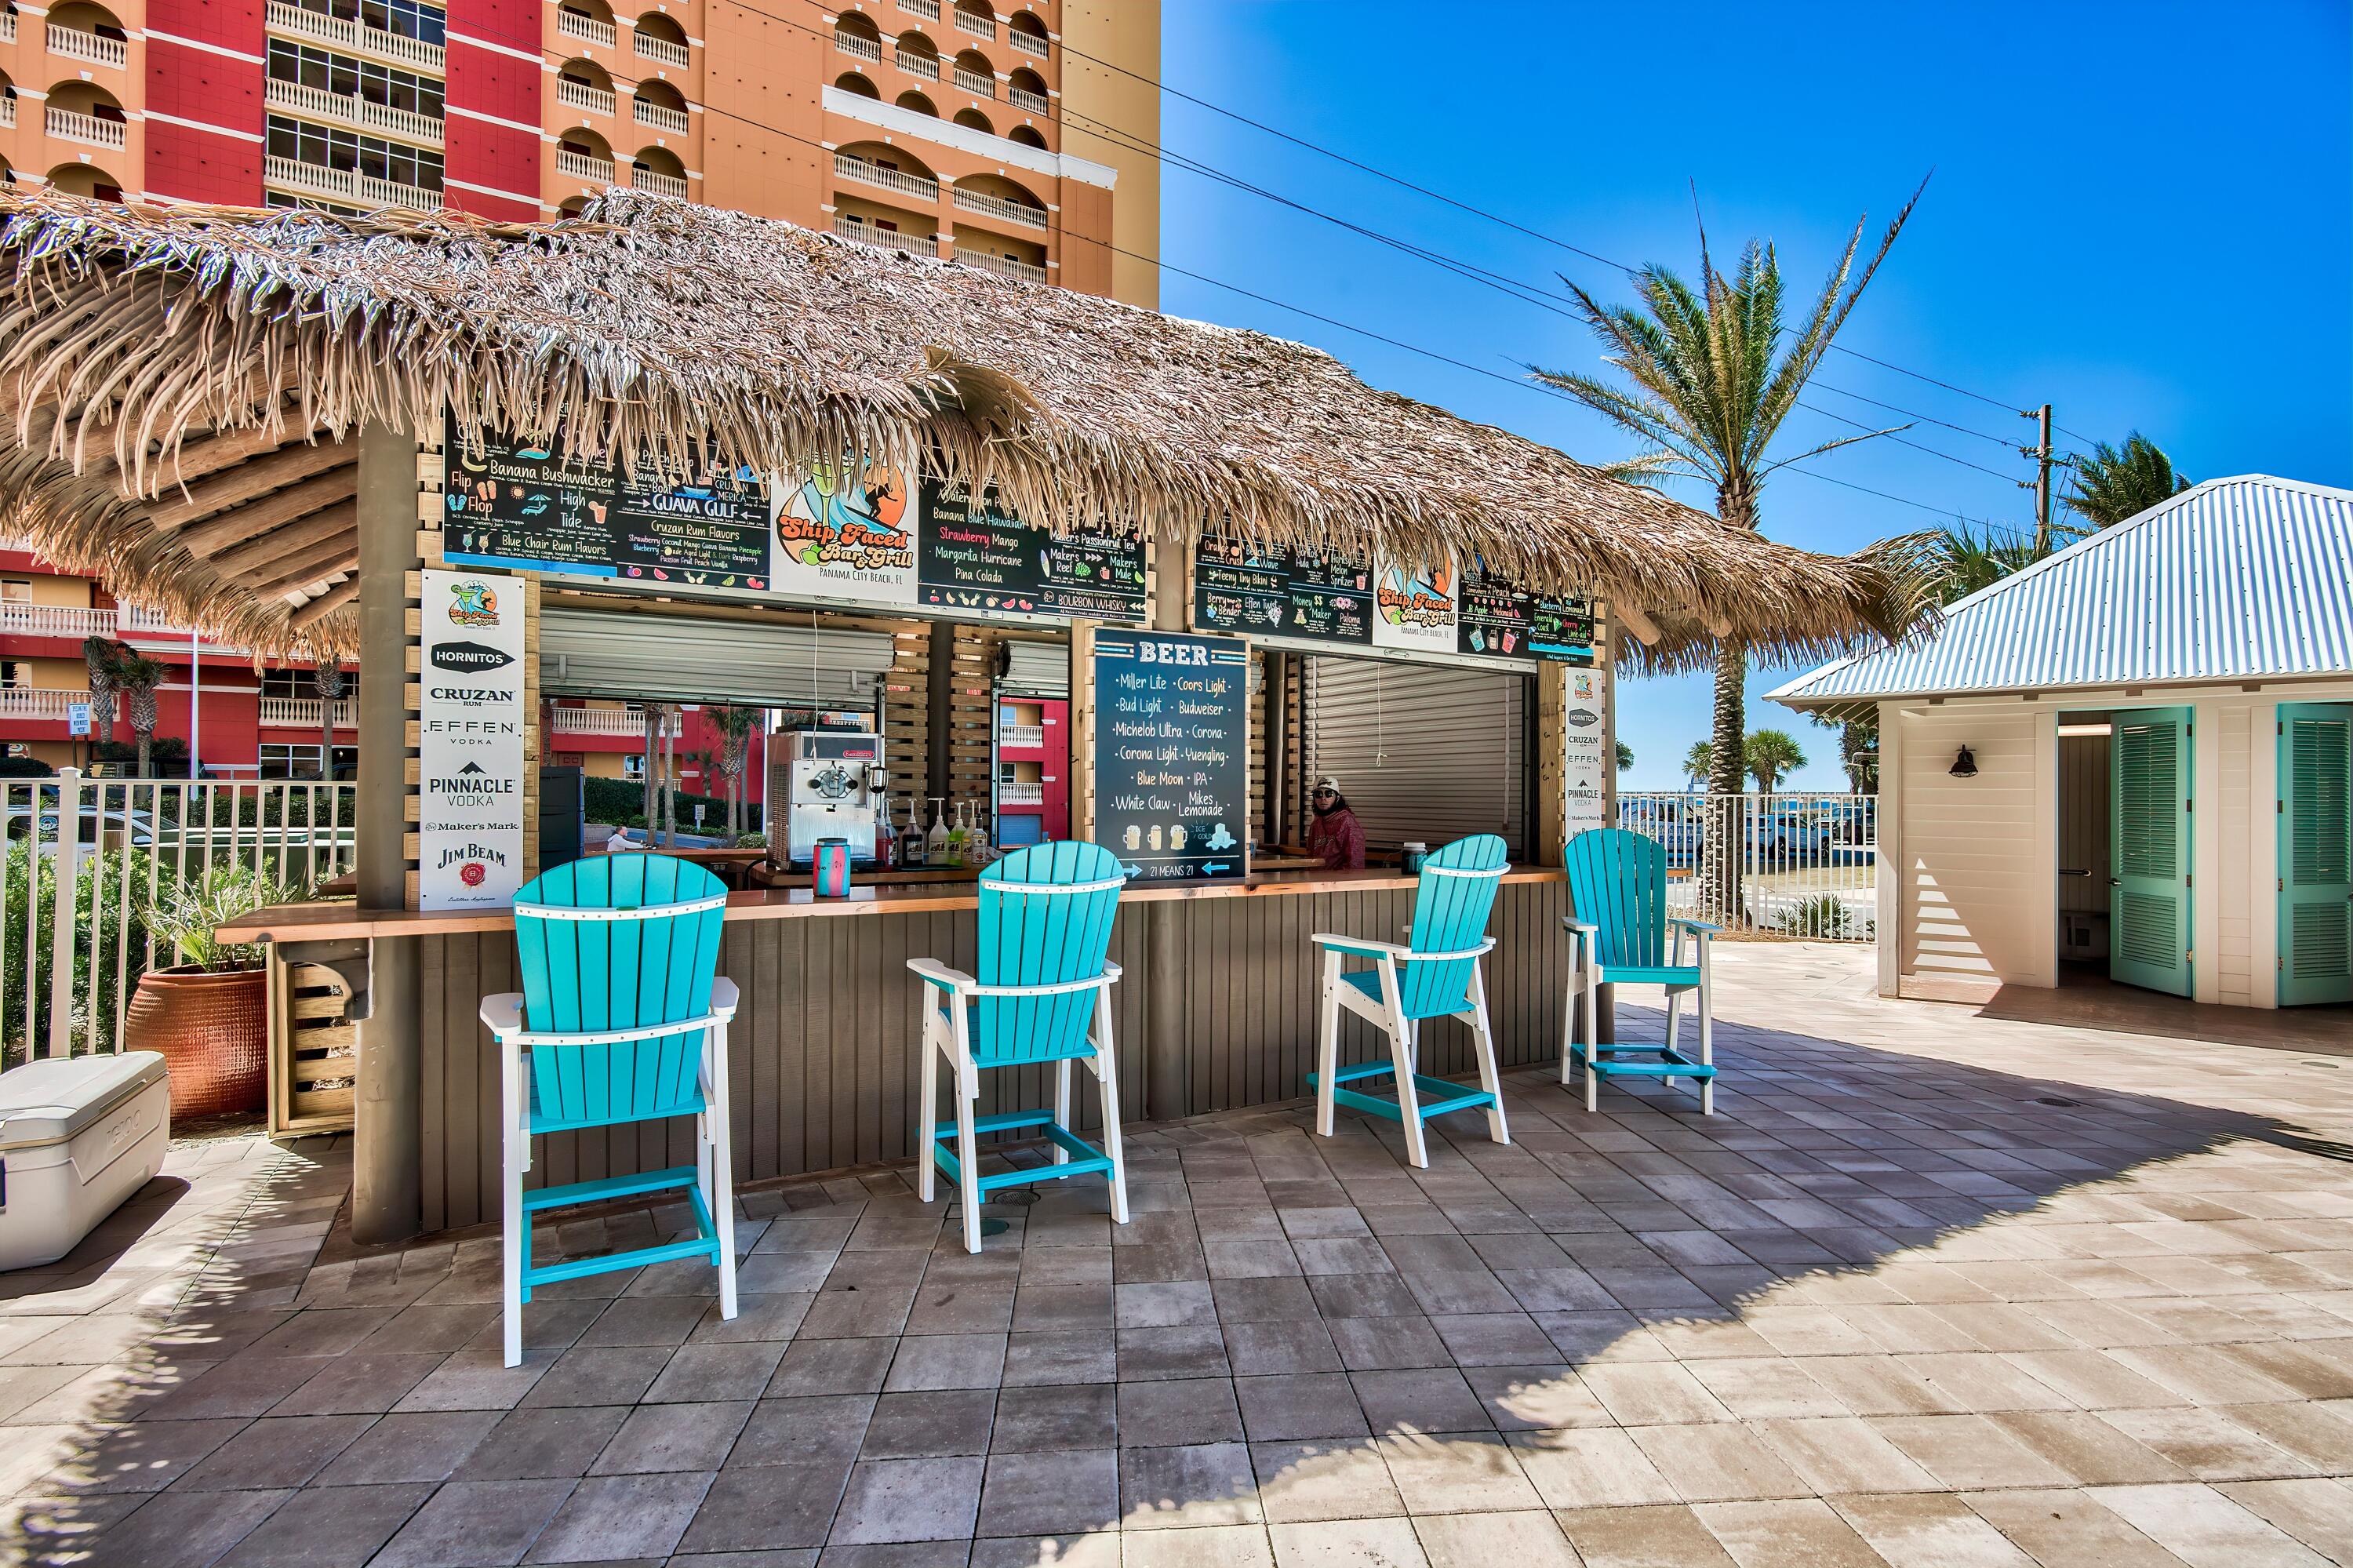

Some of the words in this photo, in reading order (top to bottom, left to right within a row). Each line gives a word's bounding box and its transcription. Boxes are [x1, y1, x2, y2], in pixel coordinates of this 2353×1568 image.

[452, 471, 471, 493] Flip
[490, 460, 537, 479] Banana
[543, 466, 615, 488] Bushwacker
[652, 480, 673, 495] Boat
[560, 490, 586, 511] High
[716, 490, 747, 503] 'MERICA
[468, 497, 493, 519] Flop
[653, 494, 700, 514] GUAVA
[705, 500, 739, 518] GULF
[560, 512, 582, 528] Tide
[933, 507, 966, 522] Banana
[968, 513, 984, 524] Blue
[987, 515, 1025, 529] Hawaiian
[651, 520, 684, 535] Cruzan
[686, 525, 706, 537] Rum
[709, 526, 740, 540] Flavors
[779, 515, 836, 547] Ship
[839, 522, 909, 550] Faced
[502, 534, 521, 547] Blue
[525, 536, 549, 550] Chair
[552, 539, 572, 552] Rum
[575, 541, 606, 555] Flavors
[628, 534, 660, 546] Strawberry
[661, 537, 682, 547] Coconut
[683, 540, 700, 550] Mango
[701, 542, 718, 551] Guava
[718, 544, 738, 552] Banana
[739, 546, 762, 556] Pineapple
[940, 526, 990, 549] Strawberry
[992, 533, 1019, 551] Mango
[1081, 534, 1122, 549] Passionfruit
[1123, 539, 1135, 551] Tea
[633, 543, 660, 556] Blueberry
[684, 548, 697, 558] Aged
[698, 550, 711, 559] Light
[732, 554, 758, 565] Raspberry
[660, 555, 680, 564] Passion
[681, 556, 693, 565] Fruit
[694, 558, 710, 567] Peach
[711, 559, 728, 569] Vanilla
[819, 541, 863, 562] Bar
[864, 546, 914, 569] Grill
[935, 546, 978, 564] Margarita
[980, 551, 1023, 566] Hurricane
[1050, 548, 1080, 562] Maker's
[1110, 555, 1137, 569] Maker's
[1056, 561, 1074, 573] Reef
[1259, 558, 1278, 569] Wave
[1296, 557, 1310, 569] Hula
[1330, 564, 1348, 576] Melon
[896, 574, 903, 585] FL
[955, 567, 973, 581] Pina
[976, 569, 1003, 584] Colada
[1115, 567, 1132, 580] Mule
[1217, 569, 1237, 586] Teeny
[1239, 572, 1251, 588] Tiny
[1252, 573, 1268, 586] Bikini
[1330, 574, 1355, 589] Spritzer
[1378, 588, 1411, 609] Ship
[1413, 592, 1453, 611] Faced
[1466, 585, 1487, 595] Somewhere
[1492, 585, 1510, 598] Peach
[1058, 595, 1093, 609] BOURBON
[1096, 597, 1126, 612] WHISKY
[1207, 591, 1227, 609] Berry
[1245, 596, 1260, 609] Effen
[1262, 598, 1278, 610] Twist
[1293, 595, 1312, 611] Money
[1540, 599, 1562, 613] Blueberry
[1562, 603, 1585, 614] Lemonade
[449, 608, 471, 619] Ship
[1218, 604, 1242, 617] Bender
[1311, 607, 1332, 620] Maker
[1340, 613, 1361, 624] Paloma
[1401, 608, 1425, 622] Bar
[1427, 610, 1456, 628] Grill
[1467, 604, 1473, 613] JB
[1474, 605, 1488, 617] Apple
[1533, 612, 1553, 623] Emerald
[1537, 622, 1550, 632] Coast
[1562, 618, 1578, 631] Cherry
[436, 651, 504, 664] HORNITOS
[1140, 641, 1209, 666] BEER
[1120, 671, 1147, 690] Miller
[1150, 674, 1166, 690] Lite
[1177, 676, 1202, 692] Coors
[1206, 678, 1227, 698] Light
[430, 687, 514, 702] CRUZAN
[1119, 697, 1136, 712] Bud
[1140, 697, 1162, 718] Light
[1179, 699, 1224, 715] Budweiser
[430, 720, 514, 733] EFFEN
[1115, 720, 1155, 737] Michelob
[1158, 721, 1183, 738] Ultra
[1191, 724, 1223, 739] Corona
[1568, 736, 1598, 744] CRUZAN
[1120, 745, 1153, 760] Corona
[1156, 745, 1179, 766] Light
[1185, 746, 1225, 767] Yuengling
[1137, 769, 1155, 785] Blue
[1159, 771, 1184, 786] Moon
[1194, 772, 1208, 786] IPA
[430, 778, 513, 794] PINNACLE
[1568, 789, 1598, 799] PINNACLE
[447, 795, 494, 806] VODKA
[1115, 794, 1144, 810] White
[1148, 795, 1170, 810] Claw
[1188, 789, 1213, 806] Mikes
[1178, 801, 1223, 817] Lemonade
[438, 848, 465, 869] JIM
[467, 843, 506, 868] BEAM
[1150, 866, 1158, 877] 21
[1159, 865, 1184, 877] MEANS
[1186, 864, 1194, 875] 21
